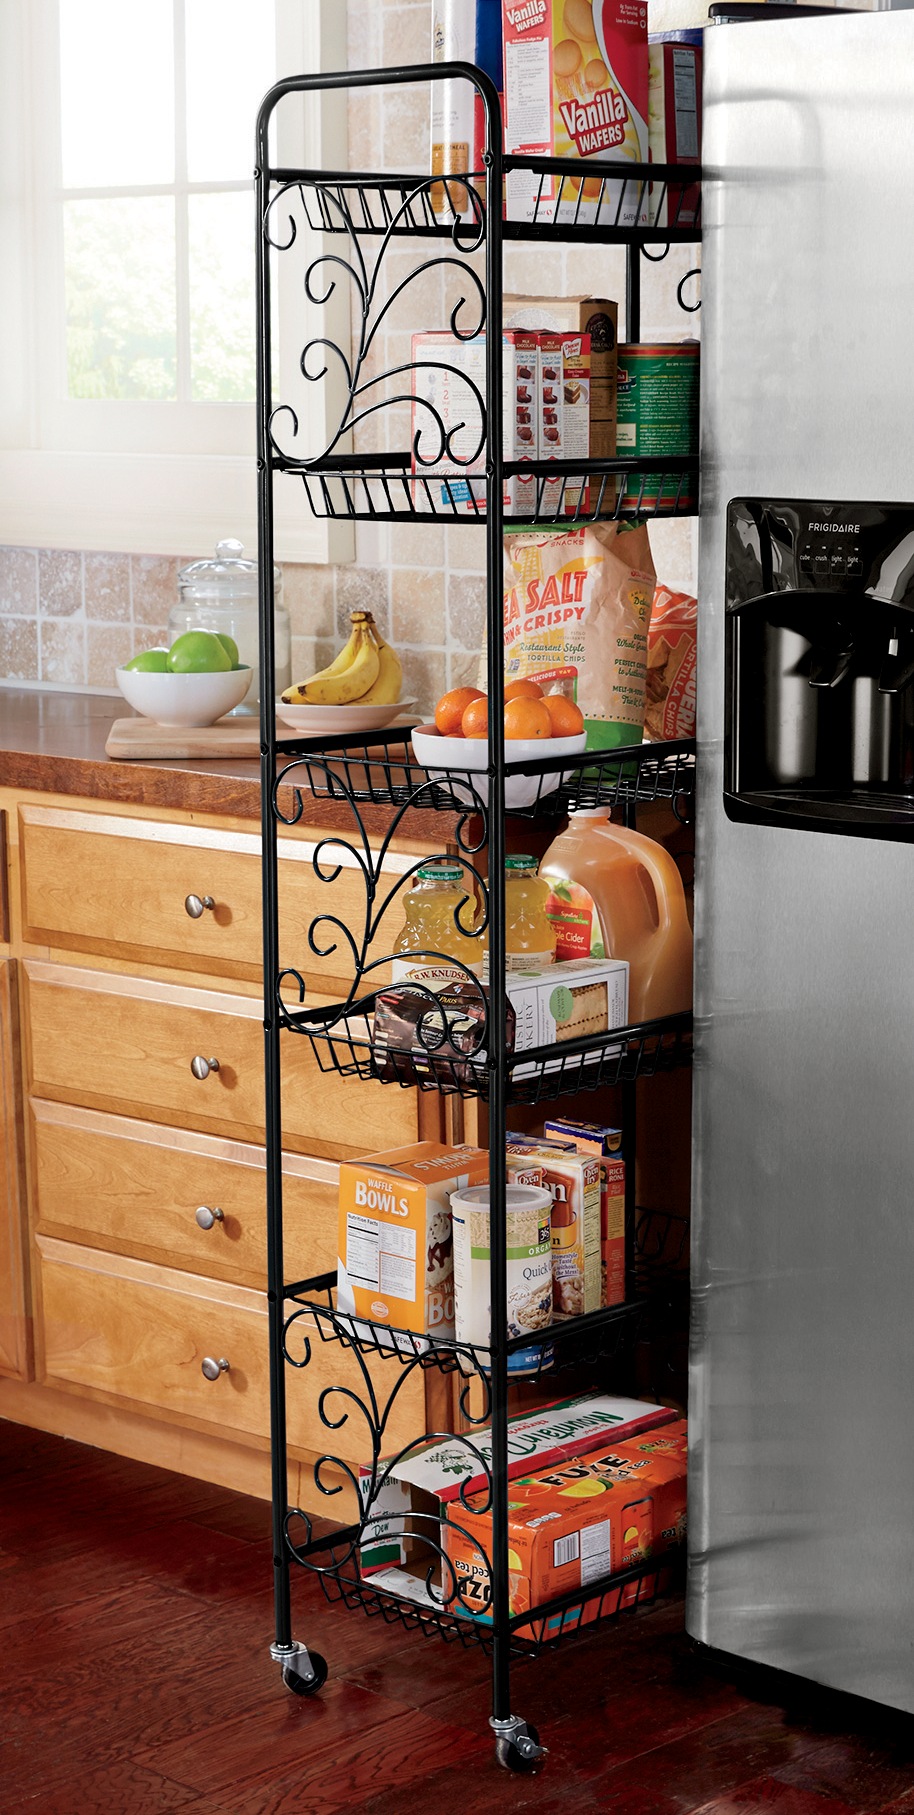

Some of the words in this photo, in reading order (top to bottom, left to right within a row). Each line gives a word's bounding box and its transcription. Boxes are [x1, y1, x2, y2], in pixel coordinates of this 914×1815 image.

[506, 0, 546, 25] Vanilla
[516, 14, 544, 33] WAFERS
[560, 91, 626, 135] Vanilla
[578, 124, 622, 153] WAFERS
[443, 389, 449, 400] 2
[443, 407, 449, 419] 3
[808, 522, 860, 533] FRIGIDAIRE
[815, 554, 828, 562] crush
[831, 555, 843, 563] light
[503, 588, 521, 628] EA
[526, 571, 588, 614] SALT
[523, 607, 586, 632] CRISPY
[520, 642, 562, 652] Restaurant
[563, 642, 586, 654] Style
[527, 654, 562, 662] TORTILLA
[664, 700, 678, 737] CHIPS
[565, 932, 585, 943] Cider
[431, 969, 470, 981] KNUDSEN
[515, 1006, 524, 1050] USTIC
[525, 1003, 534, 1049] AKERY
[413, 1151, 476, 1171] BOWLS
[584, 1166, 599, 1179] Oven
[609, 1167, 624, 1175] RICE
[367, 1178, 394, 1193] WAFFLE
[518, 1173, 540, 1186] Oven
[355, 1180, 410, 1218] BOWLS
[347, 1213, 367, 1223] Nutrition
[367, 1218, 379, 1227] Facts
[522, 1262, 549, 1281] Quick
[517, 1411, 624, 1443] Mountain
[661, 1527, 677, 1540] tea
[454, 1559, 470, 1573] tea
[472, 1565, 490, 1578] ced
